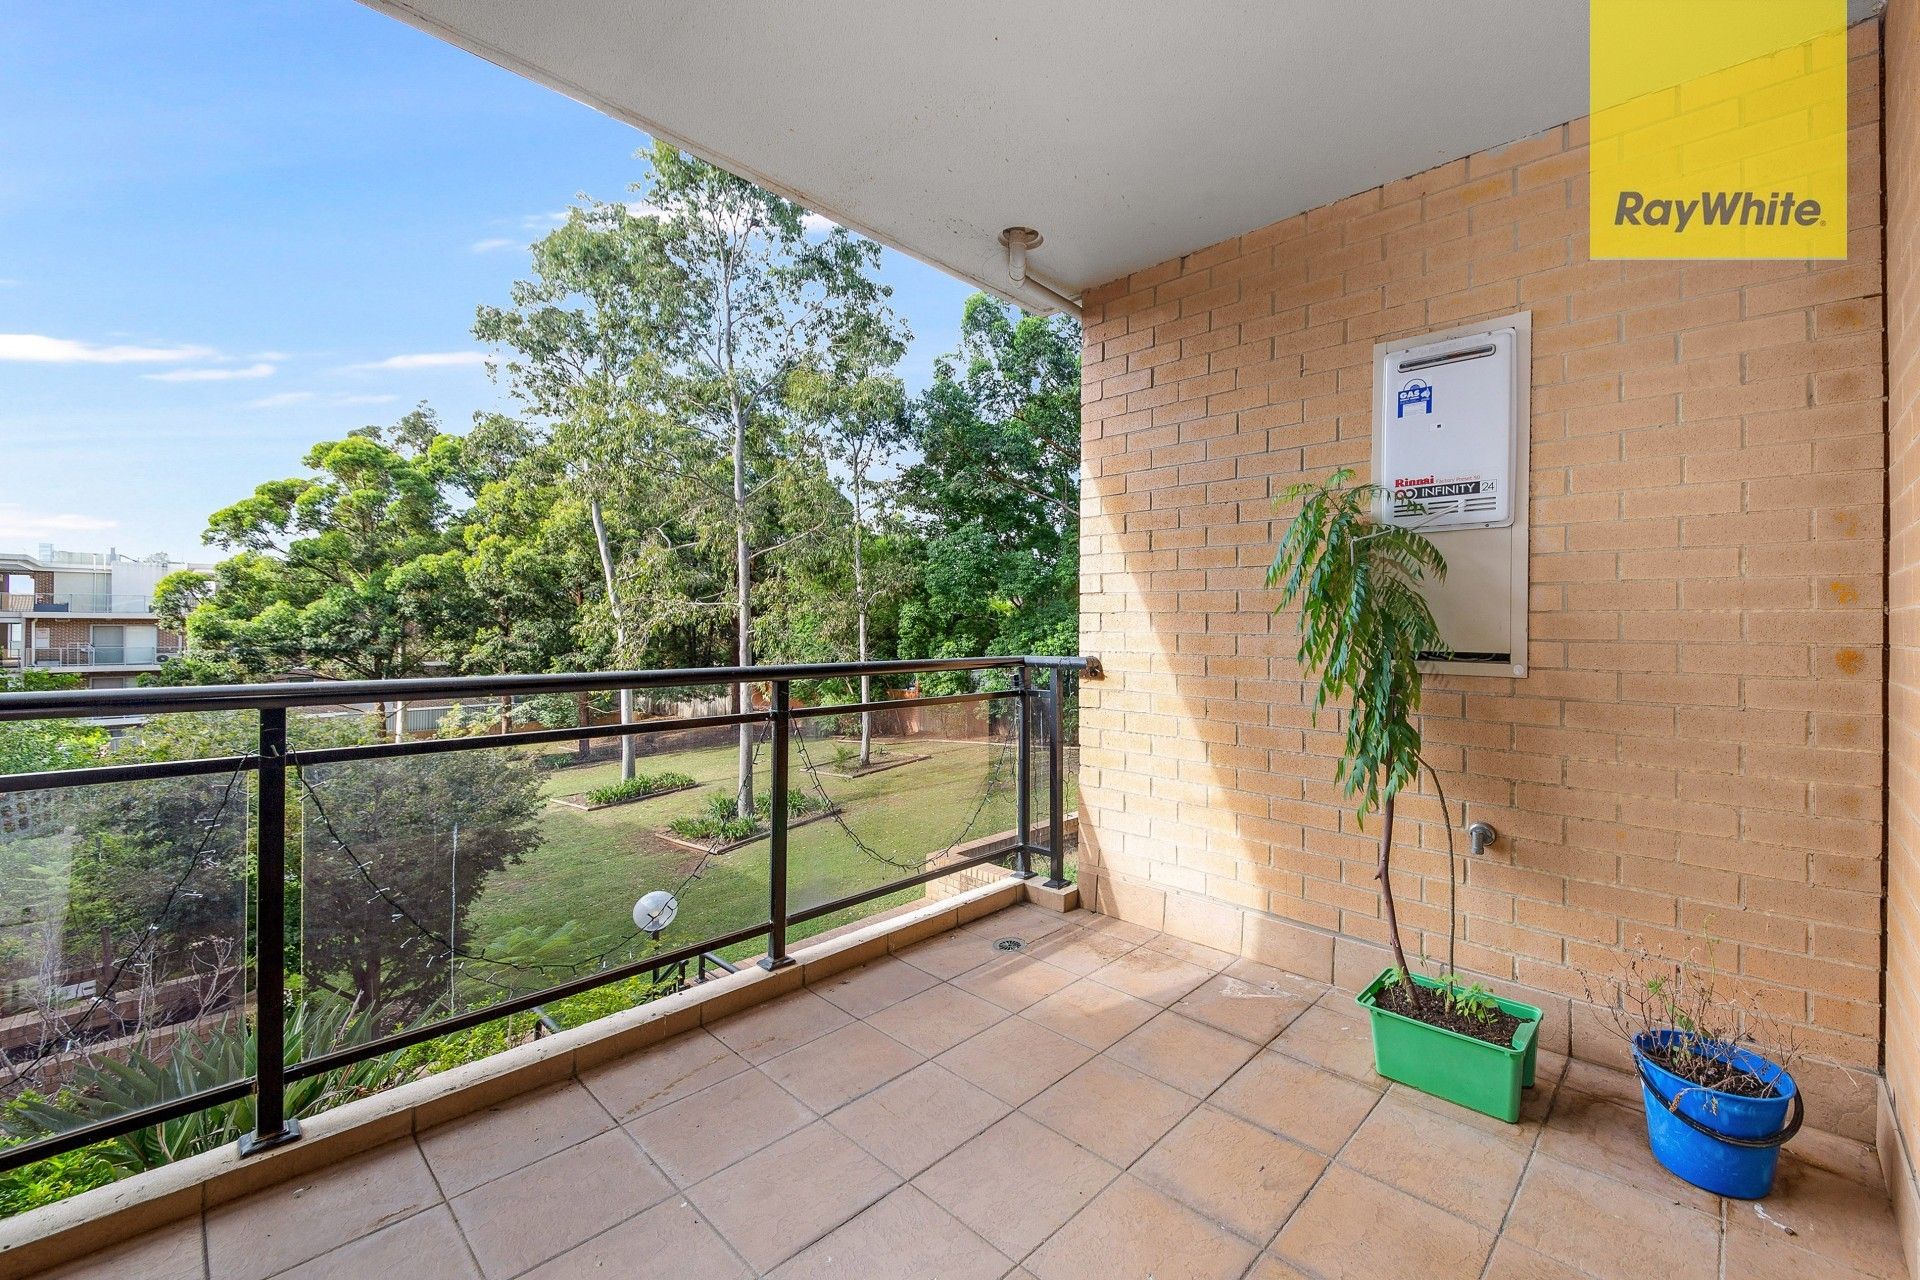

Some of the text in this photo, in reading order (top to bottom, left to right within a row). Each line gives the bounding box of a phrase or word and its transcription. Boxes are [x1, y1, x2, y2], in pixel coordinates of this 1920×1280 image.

[1400, 390, 1420, 399] GAS
[1394, 475, 1434, 487] Rinnai
[1421, 481, 1495, 497] INFINITY 24
